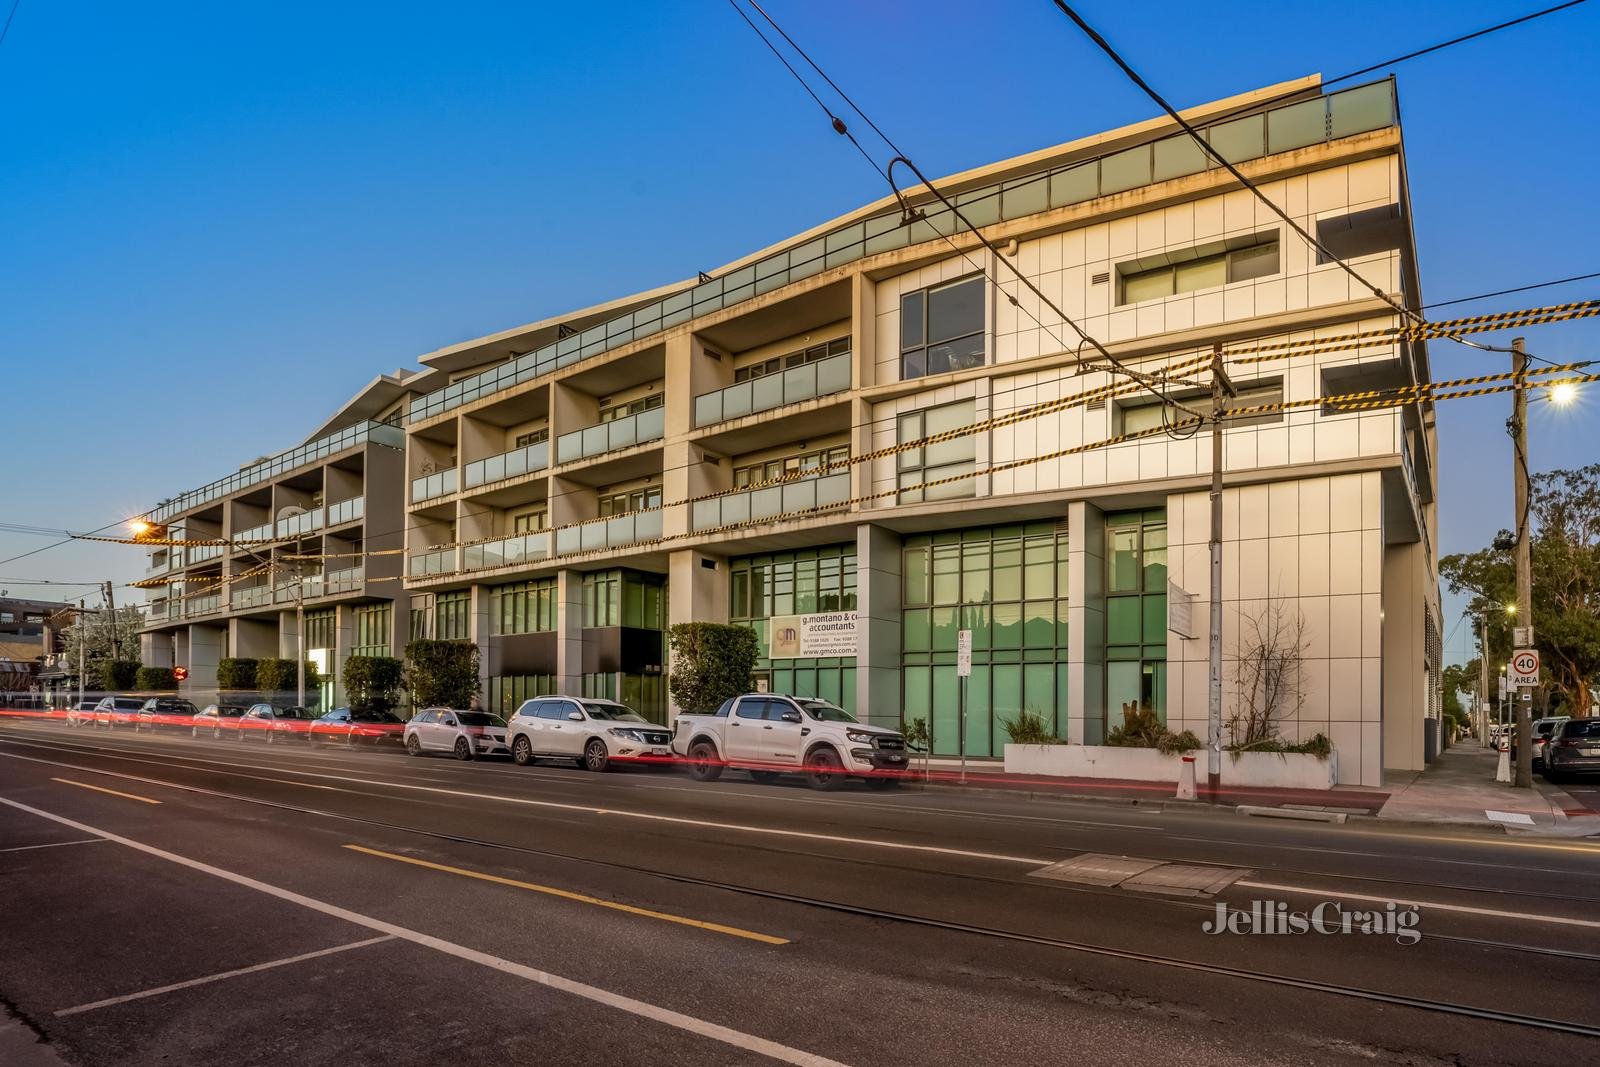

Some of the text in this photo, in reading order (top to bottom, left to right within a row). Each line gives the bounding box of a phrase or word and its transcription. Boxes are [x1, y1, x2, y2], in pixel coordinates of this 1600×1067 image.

[802, 613, 842, 625] g.montano
[844, 612, 850, 621] &
[809, 622, 855, 631] accountants
[776, 628, 796, 647] gm
[1517, 659, 1534, 668] 40
